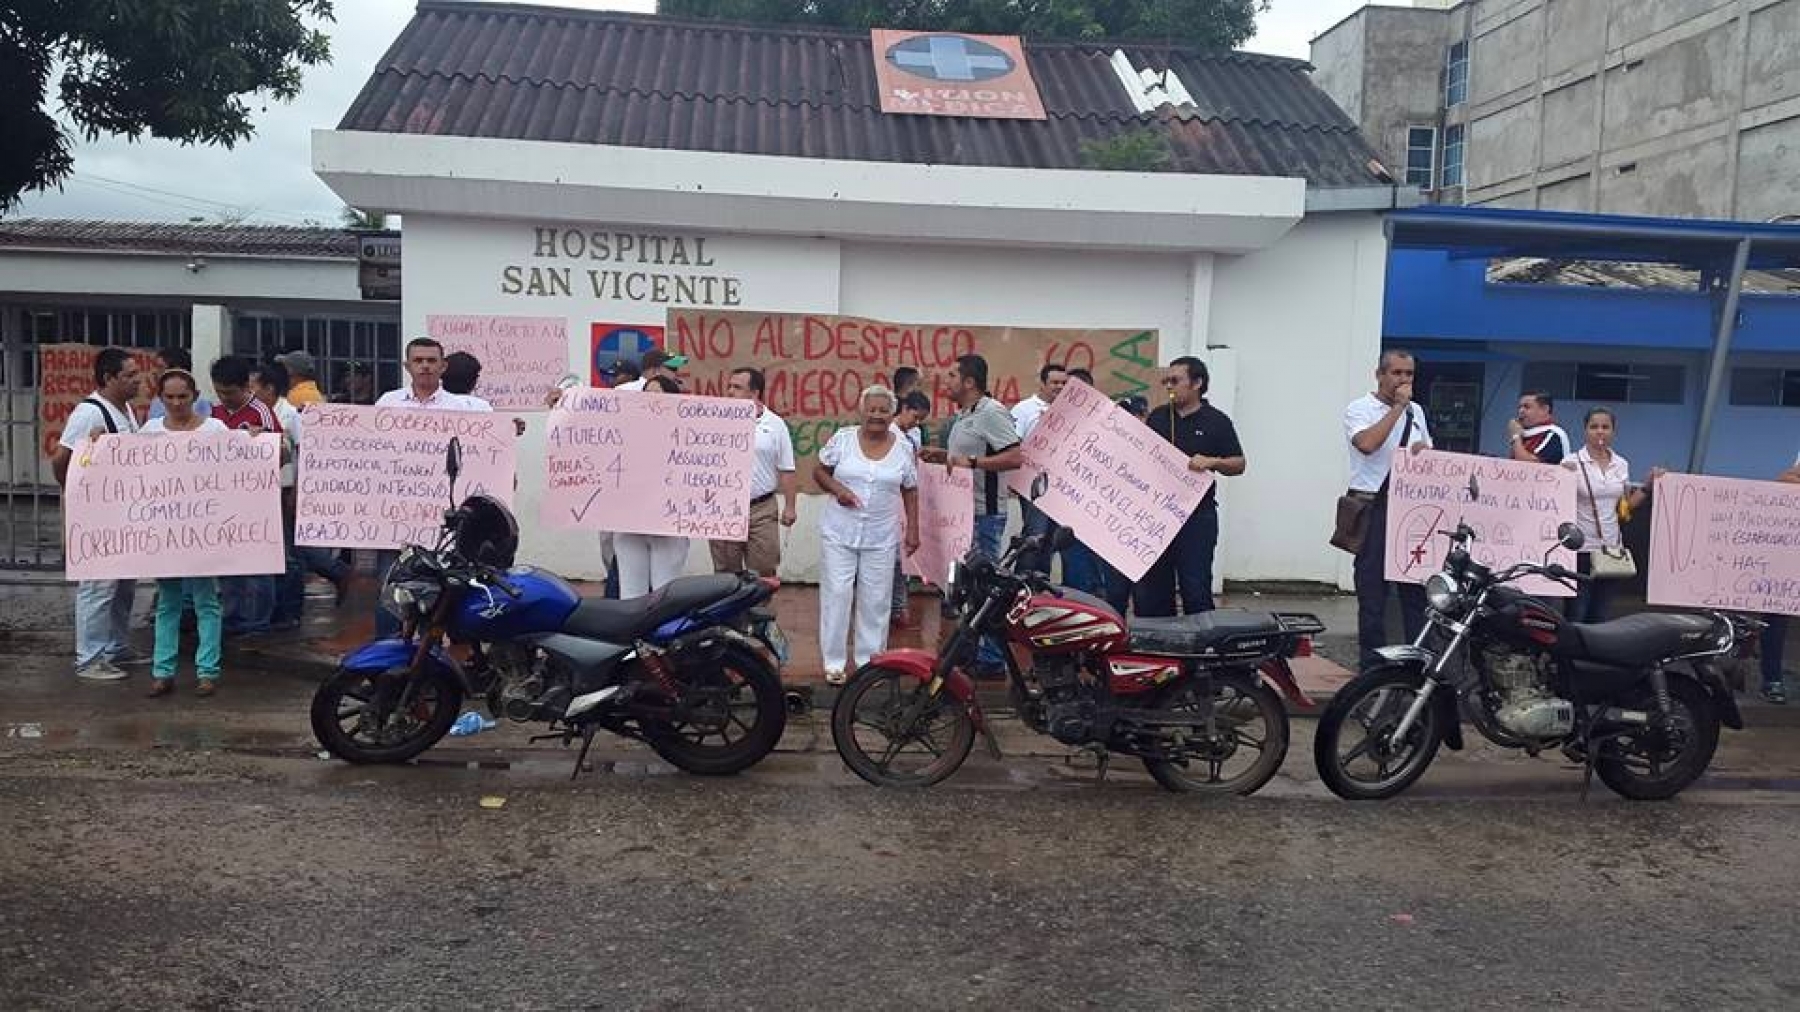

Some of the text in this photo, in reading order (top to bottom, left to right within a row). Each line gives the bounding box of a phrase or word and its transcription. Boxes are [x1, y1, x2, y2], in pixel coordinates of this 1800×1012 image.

[533, 227, 715, 267] HOSPITAL
[502, 265, 742, 306] SAN VICENTE
[676, 315, 976, 368] NO AL DESFALCO
[302, 407, 496, 437] SEÑOR GOBERNADOR
[677, 401, 756, 421] GOBERNADOR
[107, 436, 178, 466] PUEBLO
[186, 438, 220, 464] SIN
[224, 437, 274, 461] SALUD
[686, 428, 750, 452] DECRETOS
[606, 453, 625, 489] 4
[1443, 460, 1468, 476] CON
[1489, 462, 1527, 481] SALUD
[103, 476, 125, 501] LA
[130, 475, 187, 501] JUNTA
[194, 472, 226, 492] DEL
[232, 469, 279, 492] HSVA
[302, 478, 371, 496] CUIDADOS
[300, 502, 346, 517] SALUD
[1526, 492, 1560, 514] VIDA
[166, 526, 179, 549] A
[181, 528, 204, 551] LA
[298, 522, 349, 543] ABAJO
[354, 521, 380, 541] SU
[1117, 526, 1159, 566] GATO
